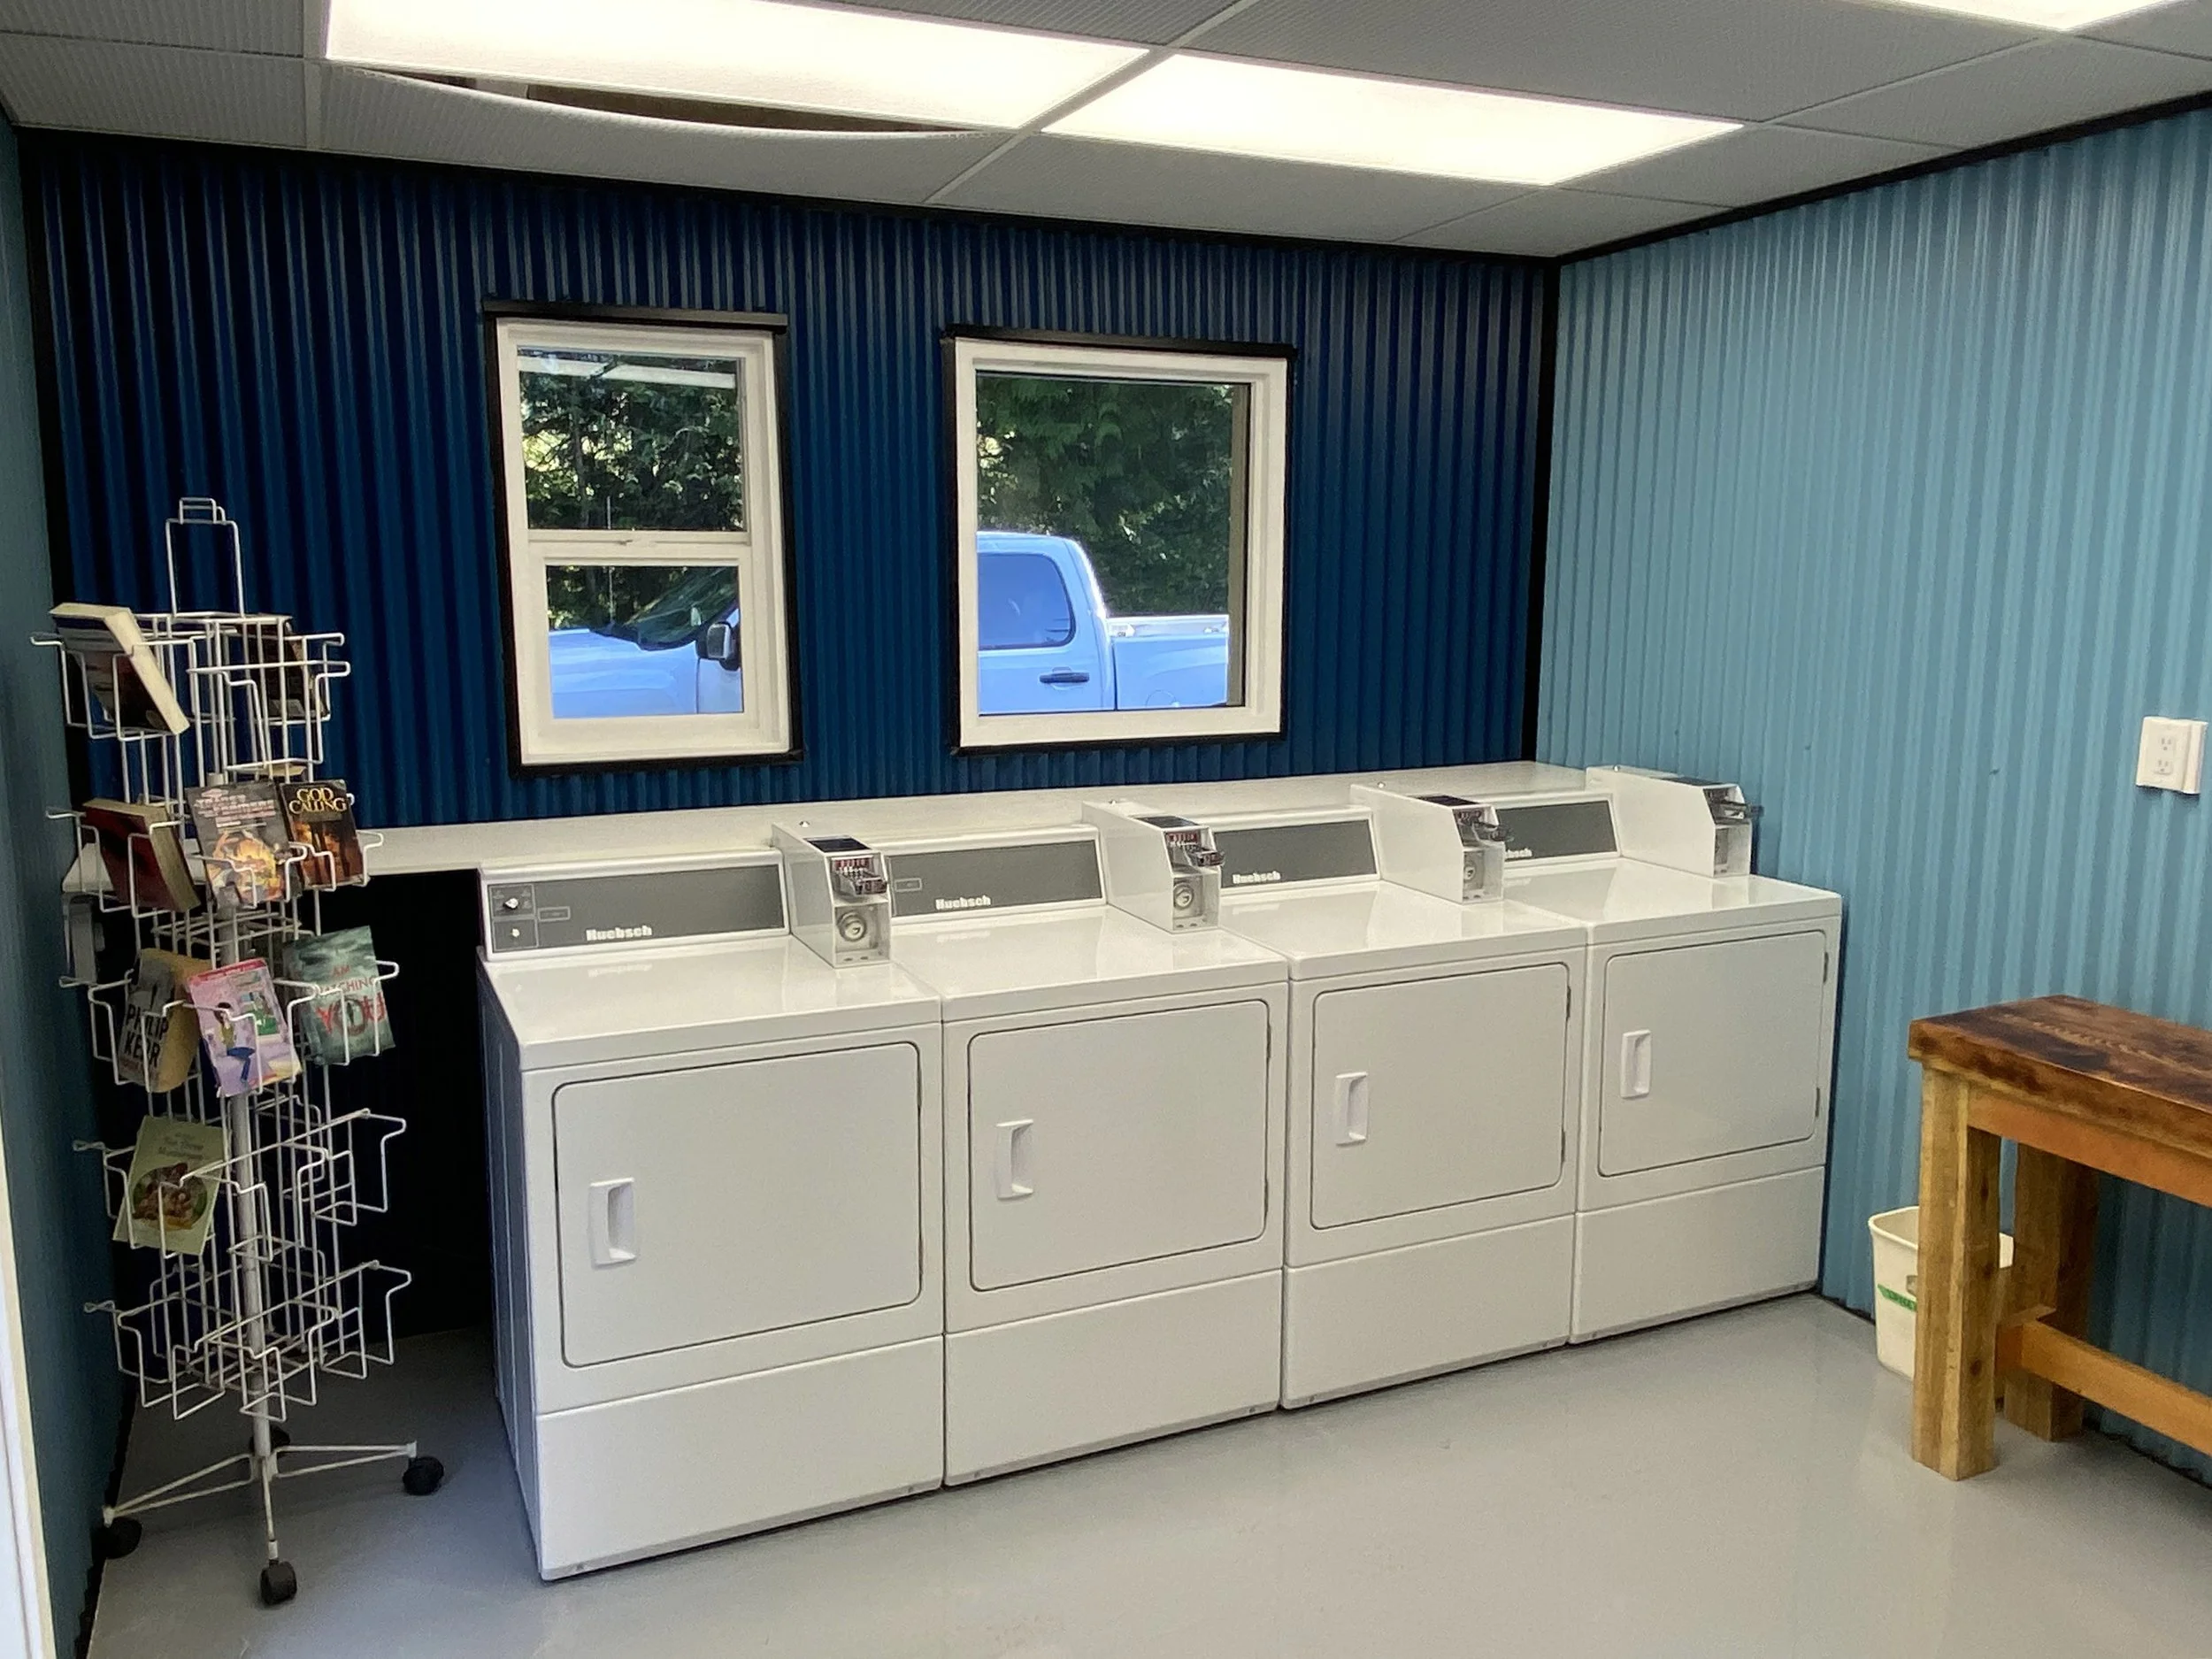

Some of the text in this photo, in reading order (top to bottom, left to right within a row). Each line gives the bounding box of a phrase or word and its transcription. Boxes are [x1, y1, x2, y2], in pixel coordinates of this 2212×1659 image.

[296, 787, 334, 803] GOD
[288, 797, 347, 815] CALLING
[935, 895, 991, 910] Huebsch
[586, 925, 652, 941] Huebsch
[126, 1003, 169, 1041] PHILIP
[316, 992, 386, 1037] YOU
